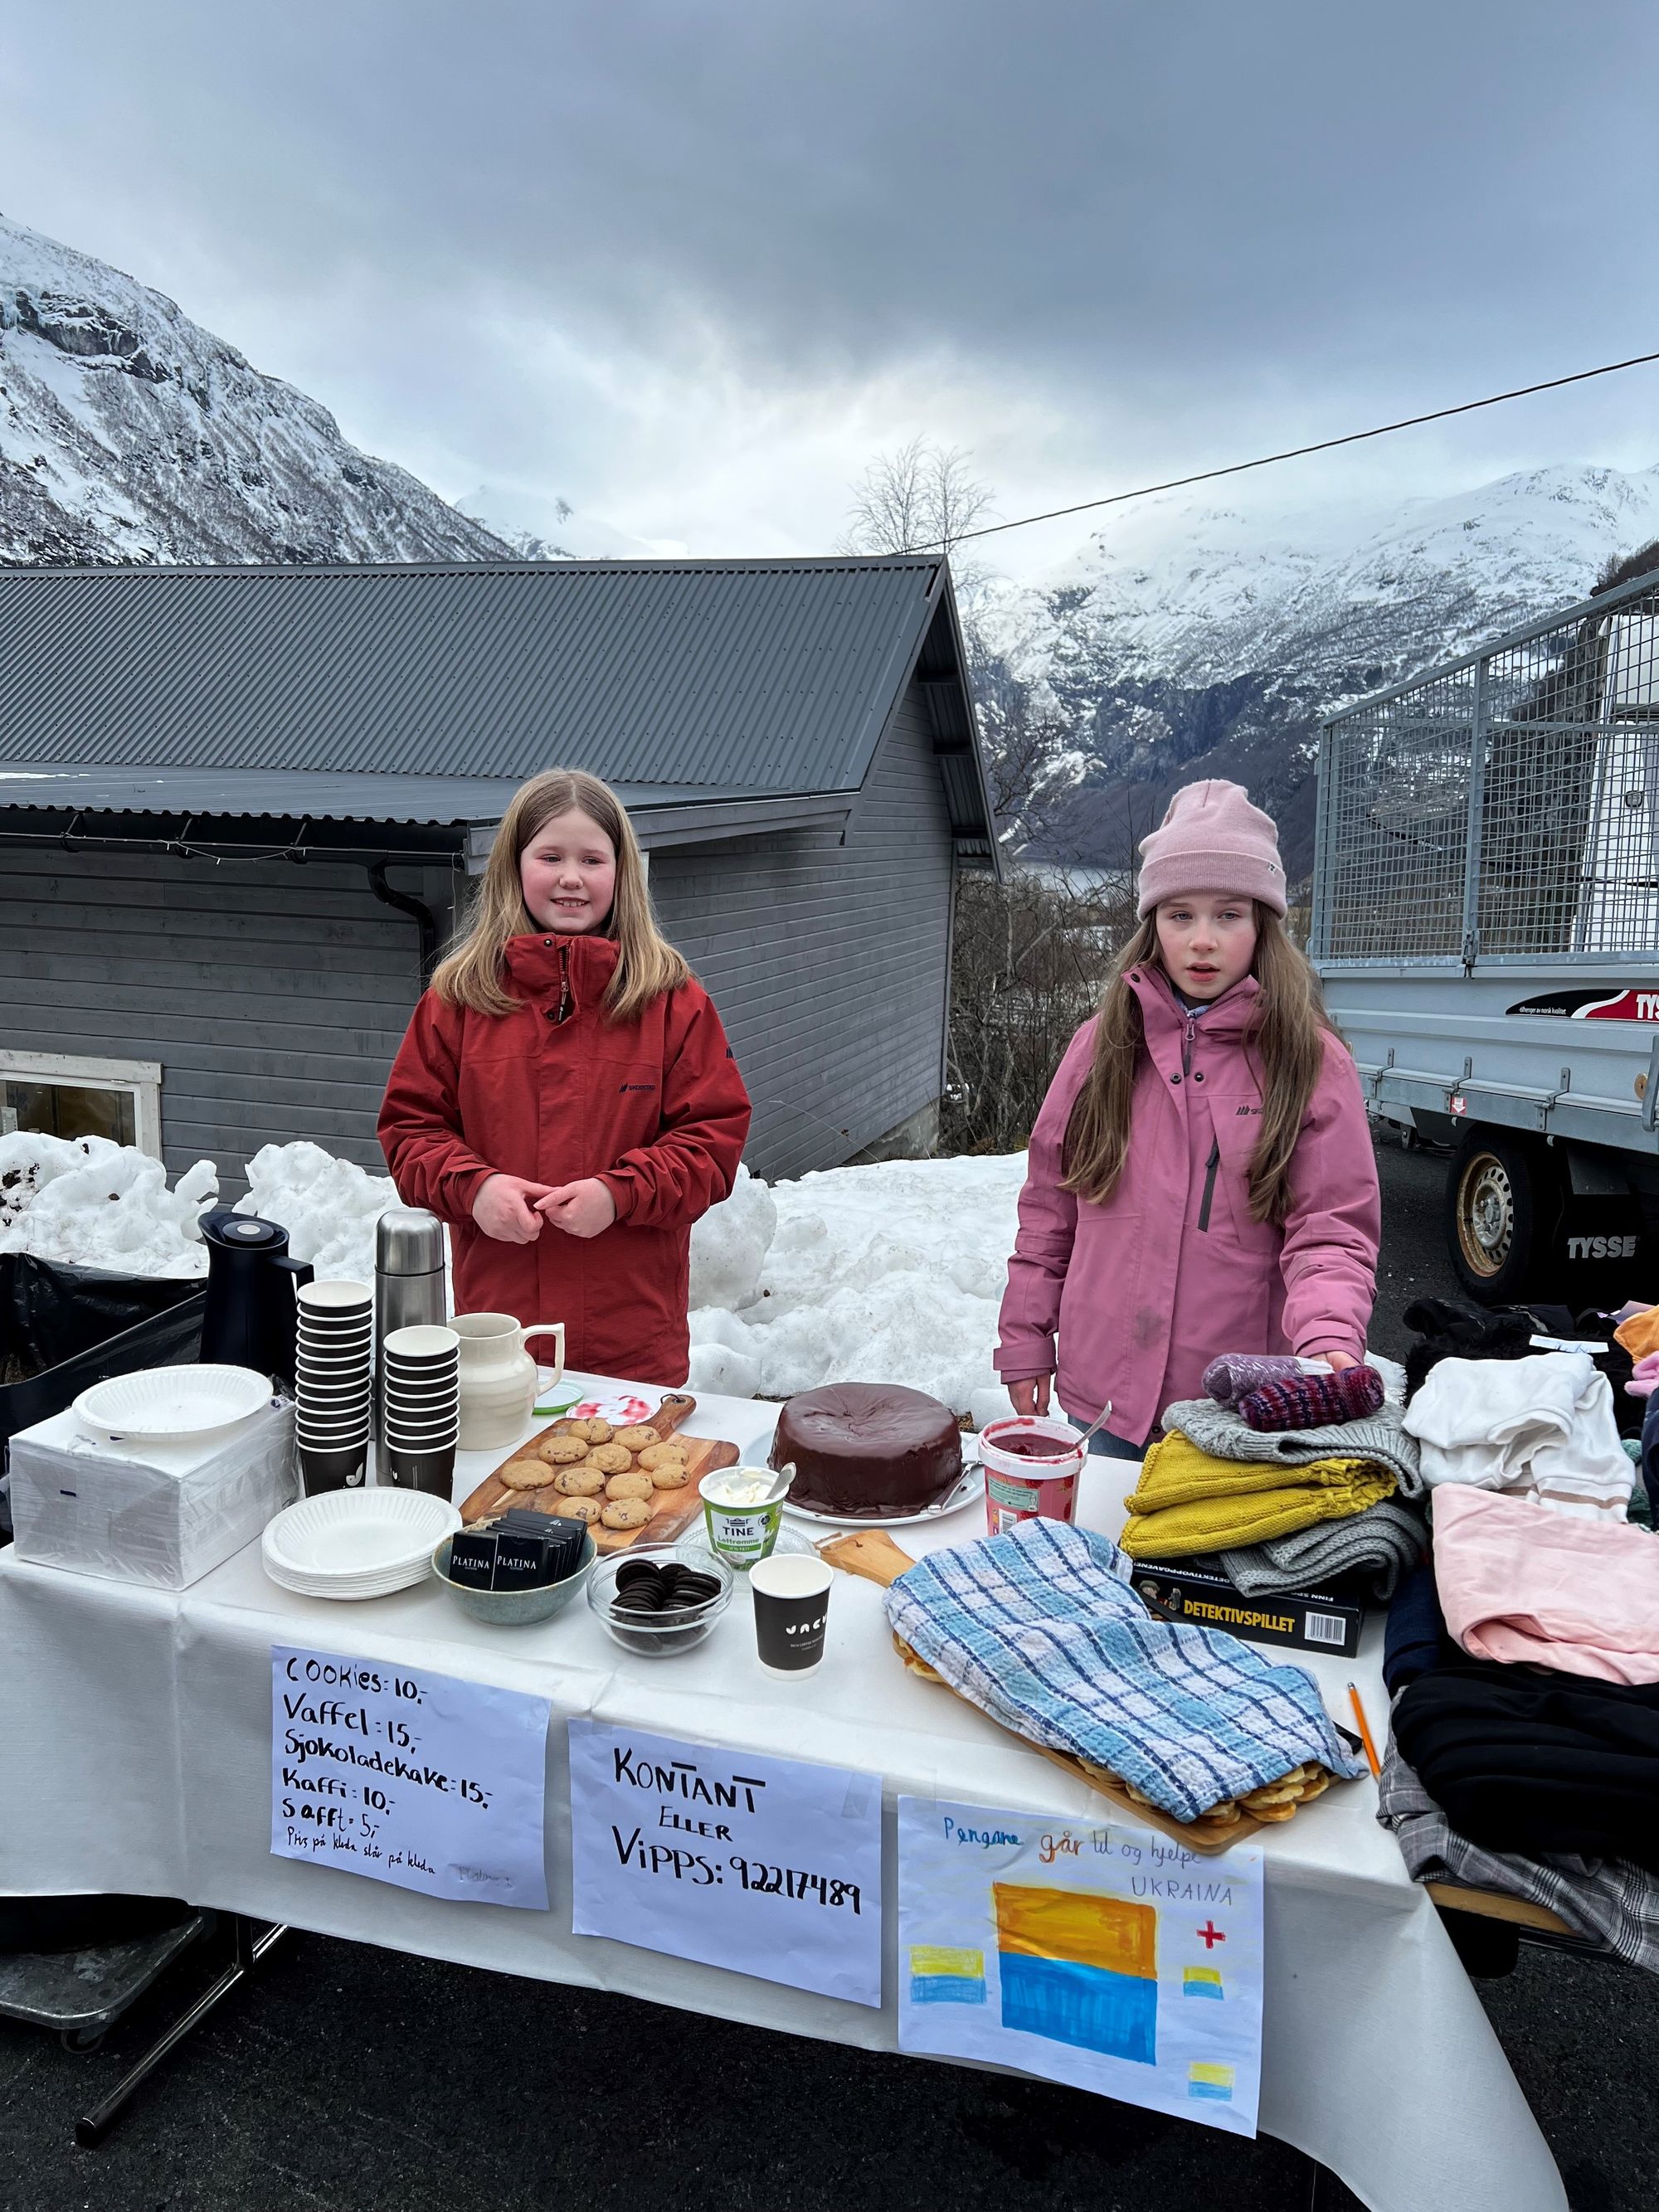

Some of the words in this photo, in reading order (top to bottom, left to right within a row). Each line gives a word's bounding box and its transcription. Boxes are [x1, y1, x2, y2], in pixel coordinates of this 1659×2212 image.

[1568, 1236, 1637, 1258] TYSSE
[722, 1526, 754, 1536] TINE
[452, 1555, 489, 1569] PLATINA
[498, 1555, 537, 1570] PLATINA
[1184, 1599, 1296, 1633] DETEKTIVSPILLET
[613, 1747, 766, 1814] KONTANT
[313, 1834, 327, 1853] på
[388, 1851, 402, 1869] på
[944, 1816, 1024, 1850] Pengane
[1039, 1830, 1083, 1864] går
[1092, 1830, 1113, 1855] til
[1121, 1844, 1141, 1865] og
[1151, 1835, 1201, 1869] hjelpe
[729, 1856, 861, 1916] 92217489
[1131, 1875, 1232, 1906] UKRAINA
